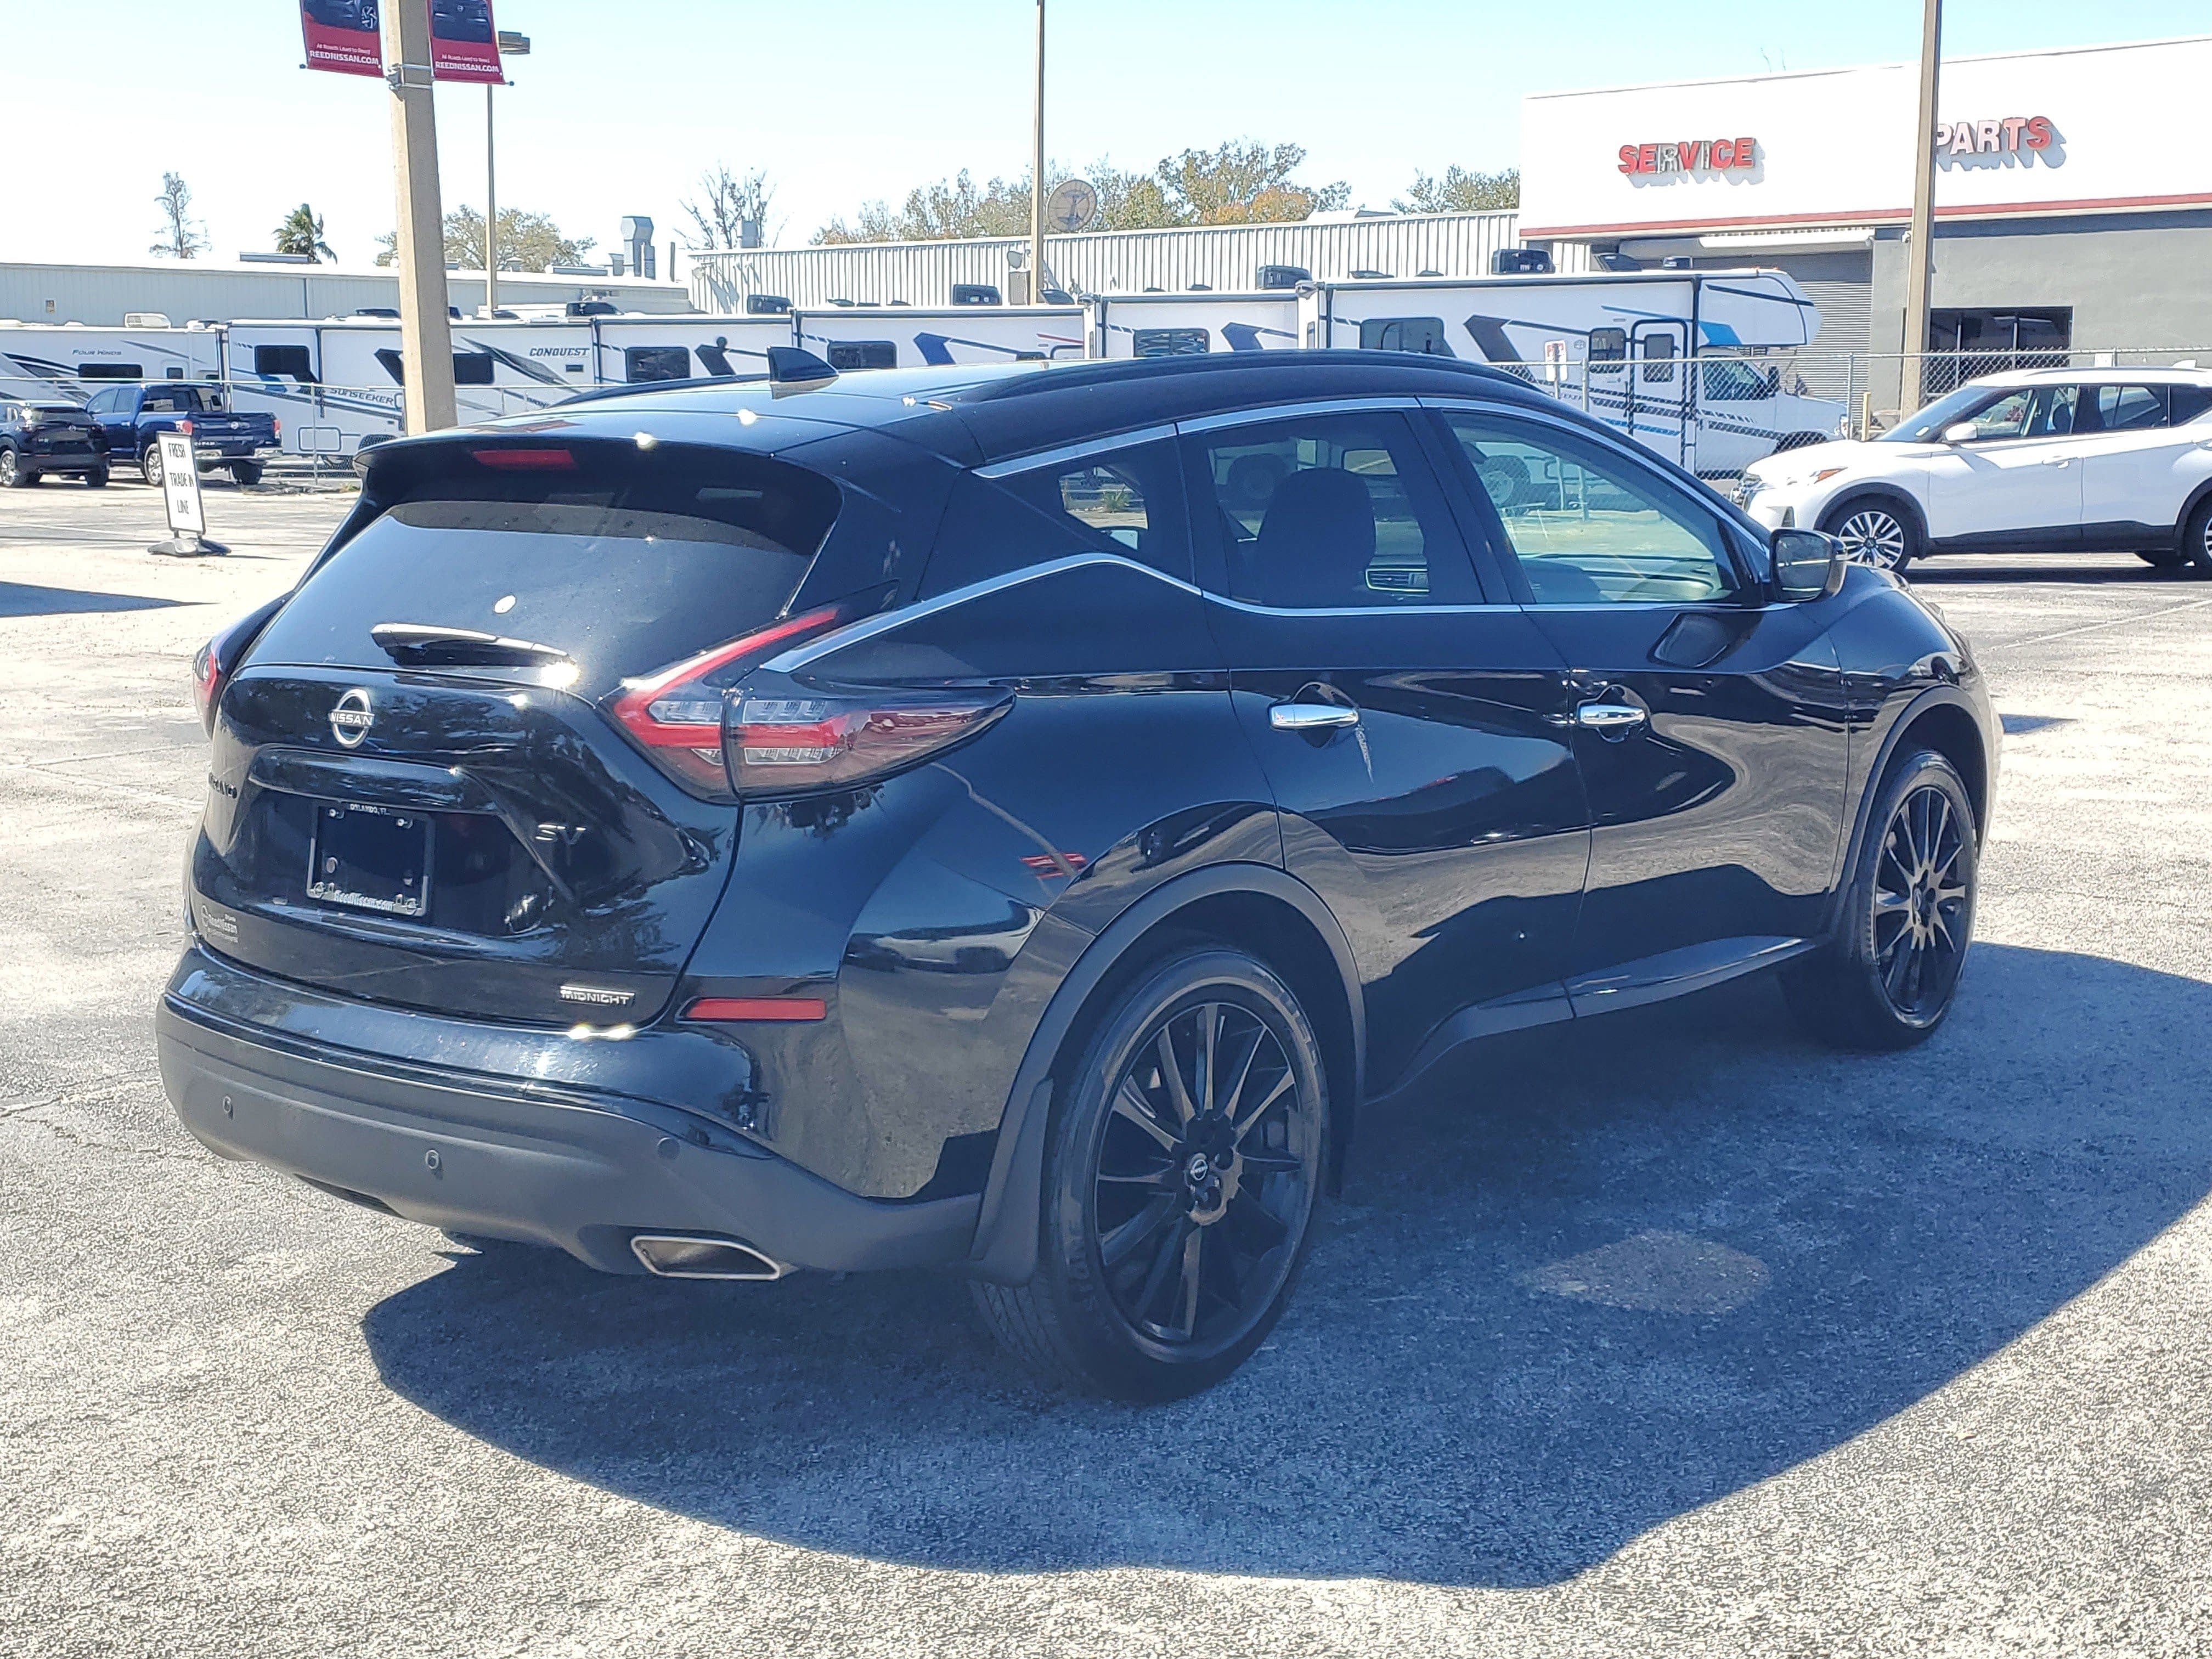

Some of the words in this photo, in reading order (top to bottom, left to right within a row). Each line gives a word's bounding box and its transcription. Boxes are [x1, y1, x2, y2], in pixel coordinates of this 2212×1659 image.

[309, 50, 379, 65] REEDNISSAN.COM
[435, 61, 499, 72] REEDNISSAN.COM
[1937, 116, 2052, 155] PARTS
[1618, 137, 1755, 174] SERVICE
[529, 347, 590, 357] CONQUEST
[330, 388, 394, 407] SUNSEEKER
[168, 443, 186, 458] FRESH
[170, 472, 188, 487] TRADE
[177, 499, 189, 515] LINE
[330, 712, 373, 726] NISSAN
[535, 823, 586, 845] SV
[561, 989, 630, 1005] MIDNIGHT
